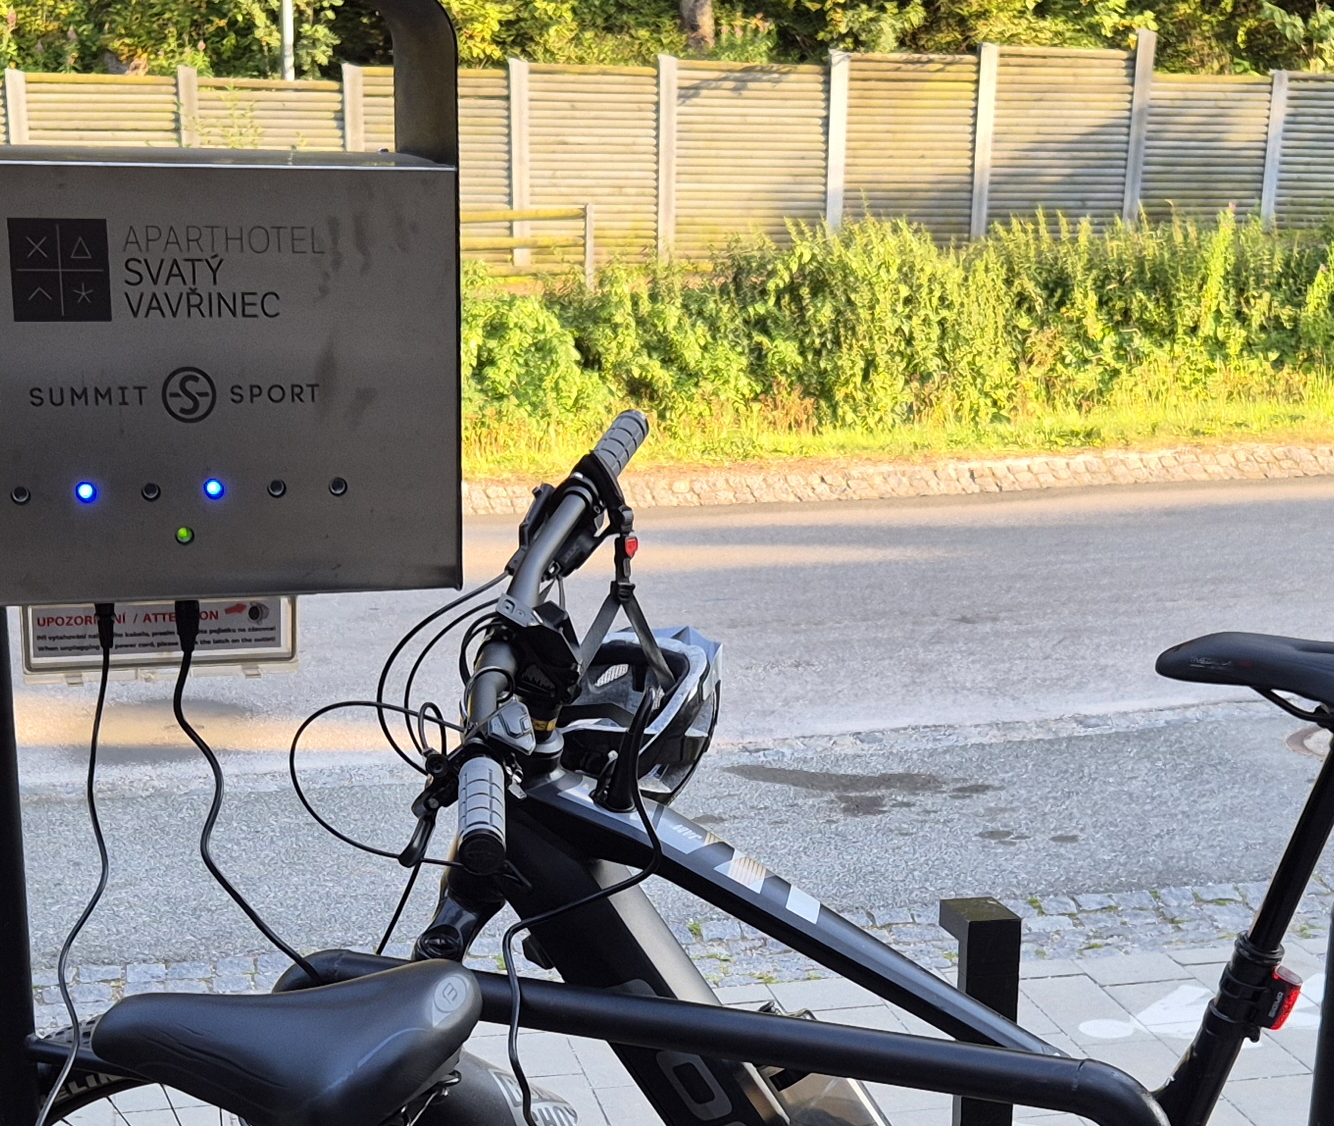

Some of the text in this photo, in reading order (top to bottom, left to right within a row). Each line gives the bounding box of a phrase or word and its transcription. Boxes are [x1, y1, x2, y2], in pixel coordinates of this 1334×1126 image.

[122, 224, 327, 254] APARTHOTEL
[123, 252, 225, 287] SVATÝ
[123, 287, 281, 319] VAVŘINEC
[28, 386, 148, 407] SUMMIT
[229, 383, 320, 404] SPORT
[36, 612, 127, 628] UPOZORNÍ
[142, 610, 220, 624] ATTEON
